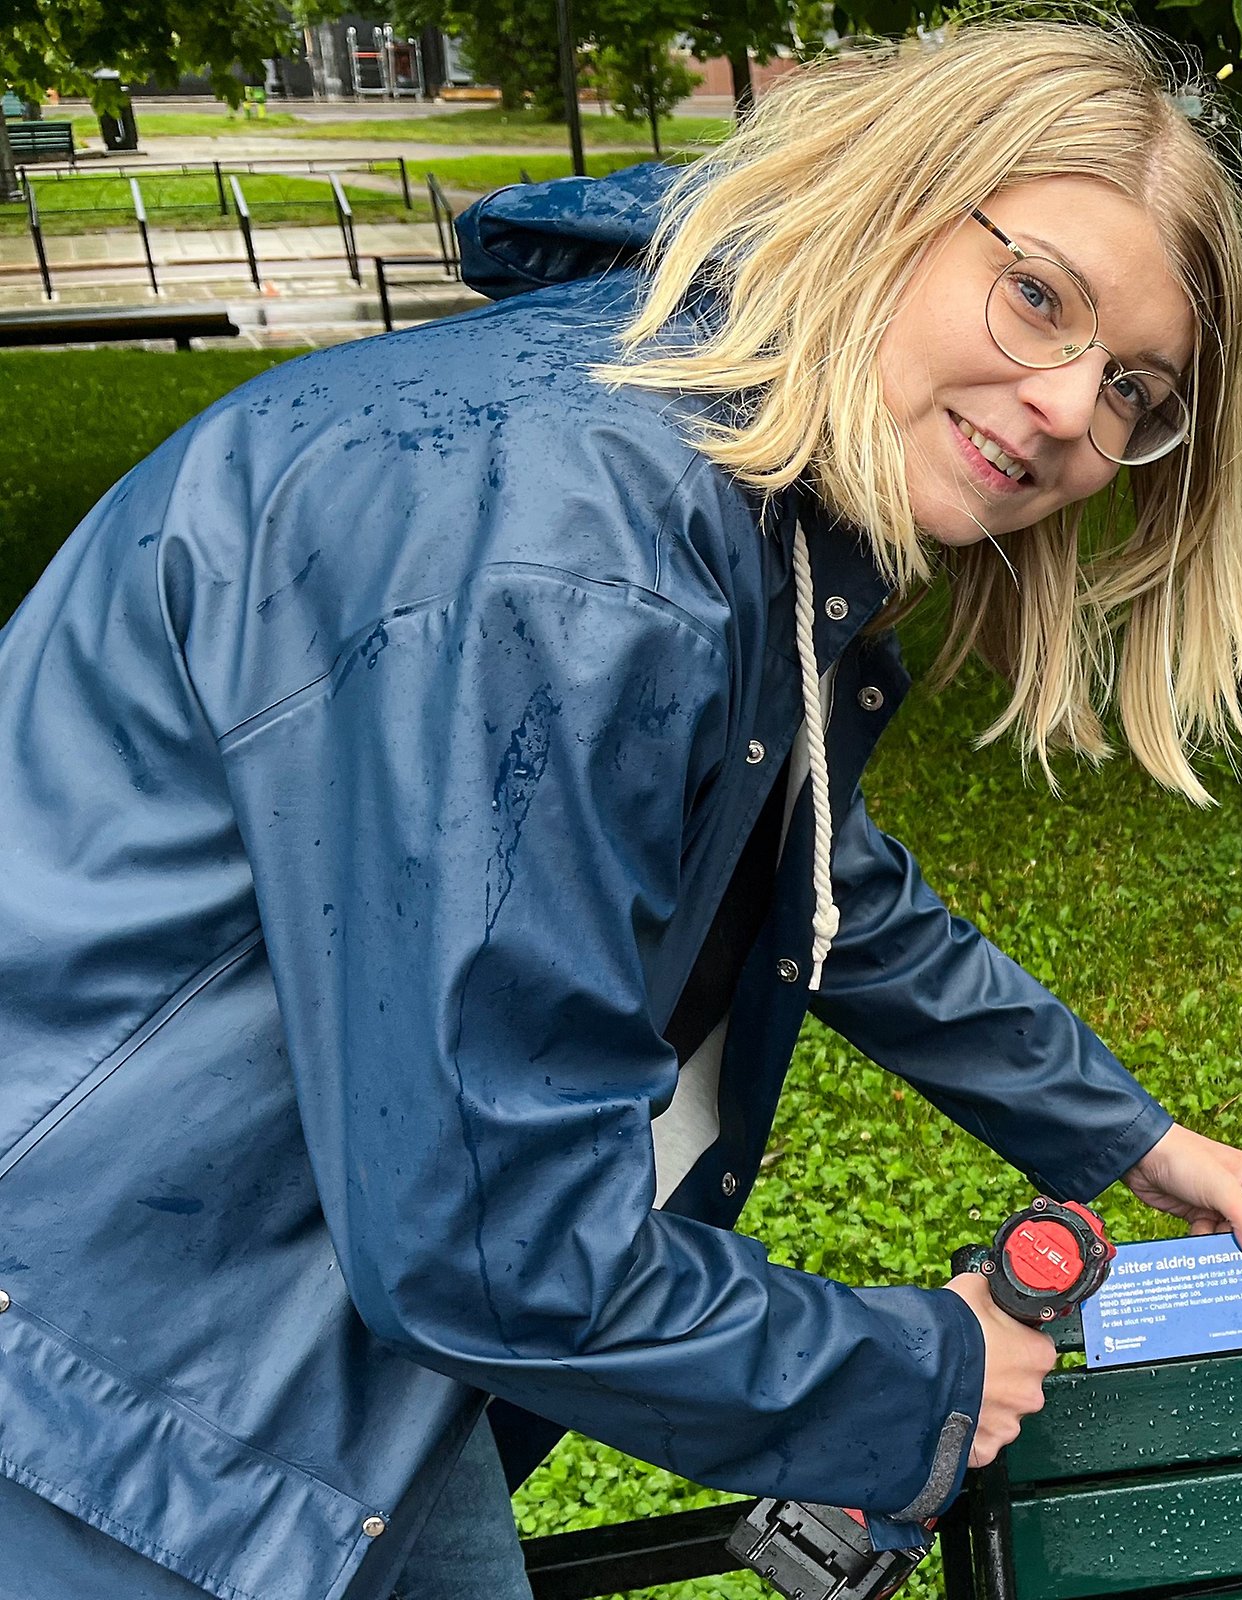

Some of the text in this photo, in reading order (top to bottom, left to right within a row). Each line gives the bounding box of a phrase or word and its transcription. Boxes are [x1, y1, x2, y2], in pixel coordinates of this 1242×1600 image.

[1019, 1229, 1071, 1275] FUEL
[1117, 1261, 1154, 1275] sitter
[1155, 1255, 1195, 1270] aldrig
[1173, 1300, 1189, 1308] med
[1111, 1319, 1123, 1328] det
